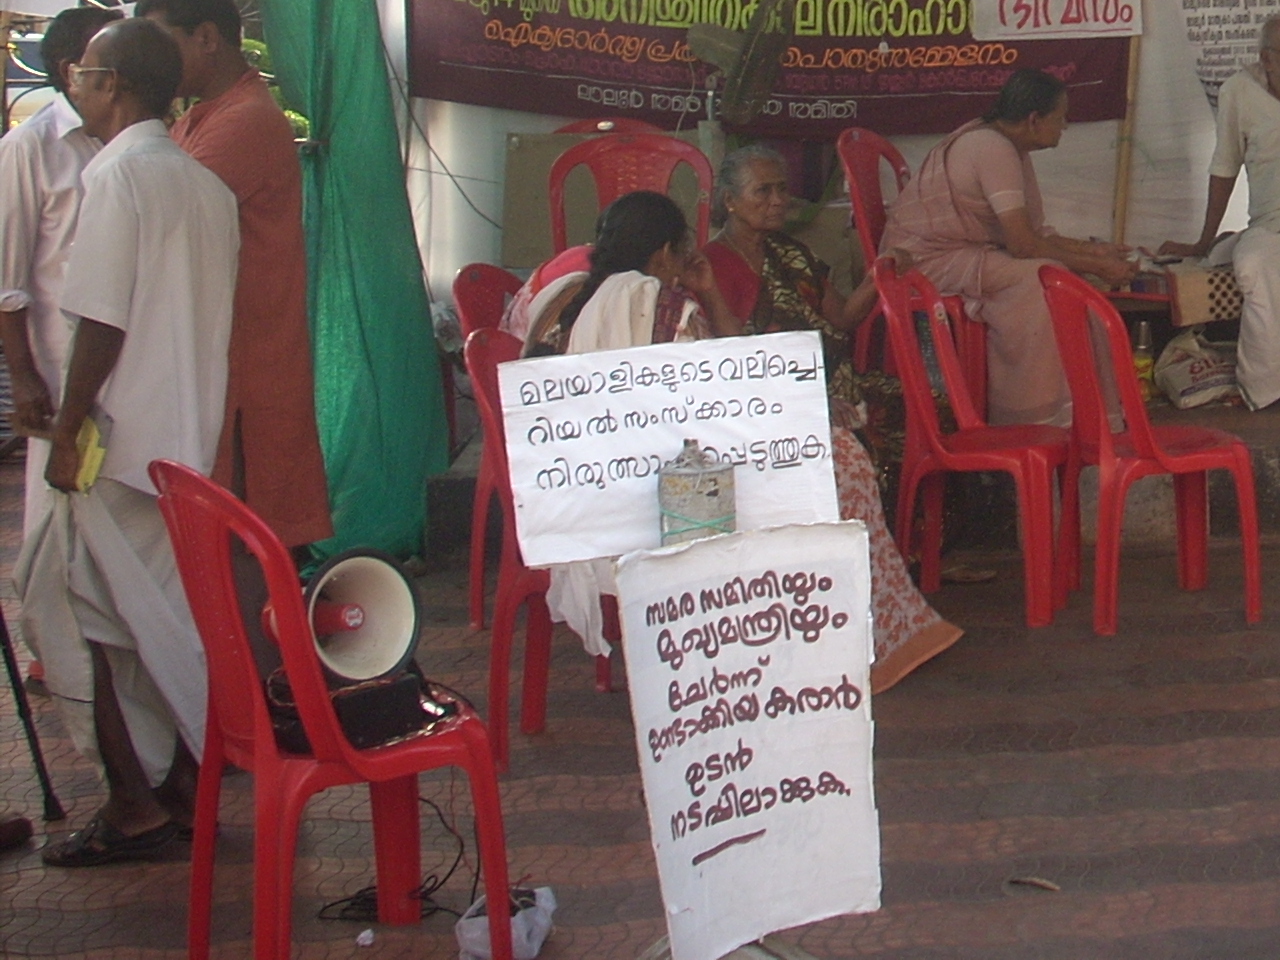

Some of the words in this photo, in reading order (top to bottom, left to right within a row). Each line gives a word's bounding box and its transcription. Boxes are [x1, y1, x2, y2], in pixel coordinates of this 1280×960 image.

[519, 360, 714, 406] മലയാളികളുടെ
[645, 591, 695, 628] സമര
[685, 737, 754, 797] ഉടൻ
